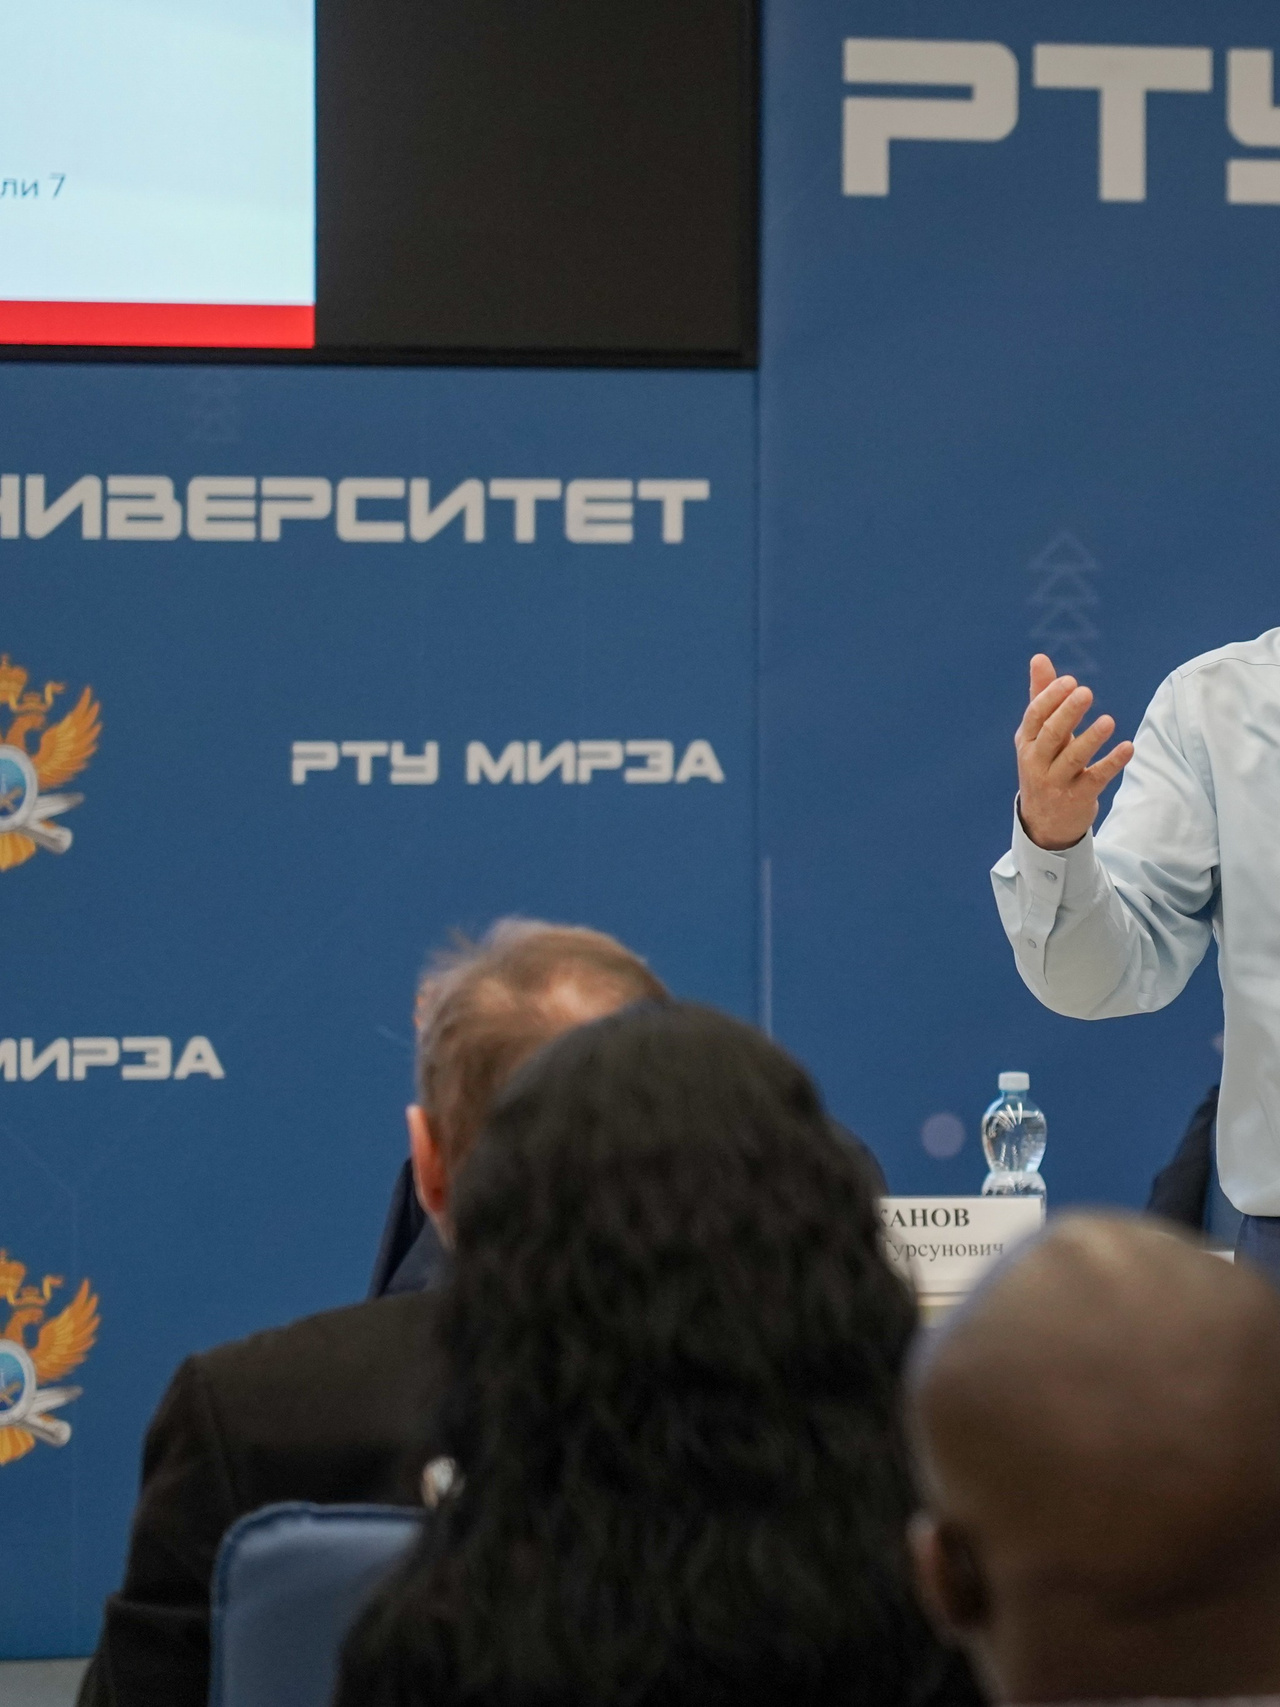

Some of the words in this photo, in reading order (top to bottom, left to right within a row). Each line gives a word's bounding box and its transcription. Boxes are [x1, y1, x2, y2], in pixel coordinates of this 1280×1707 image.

[49, 172, 66, 199] 7
[0, 474, 710, 543] ИВЕРСИТЕТ
[291, 741, 439, 784] РТУ
[466, 740, 724, 784] МИРЭА
[885, 1240, 1004, 1262] урсунович
